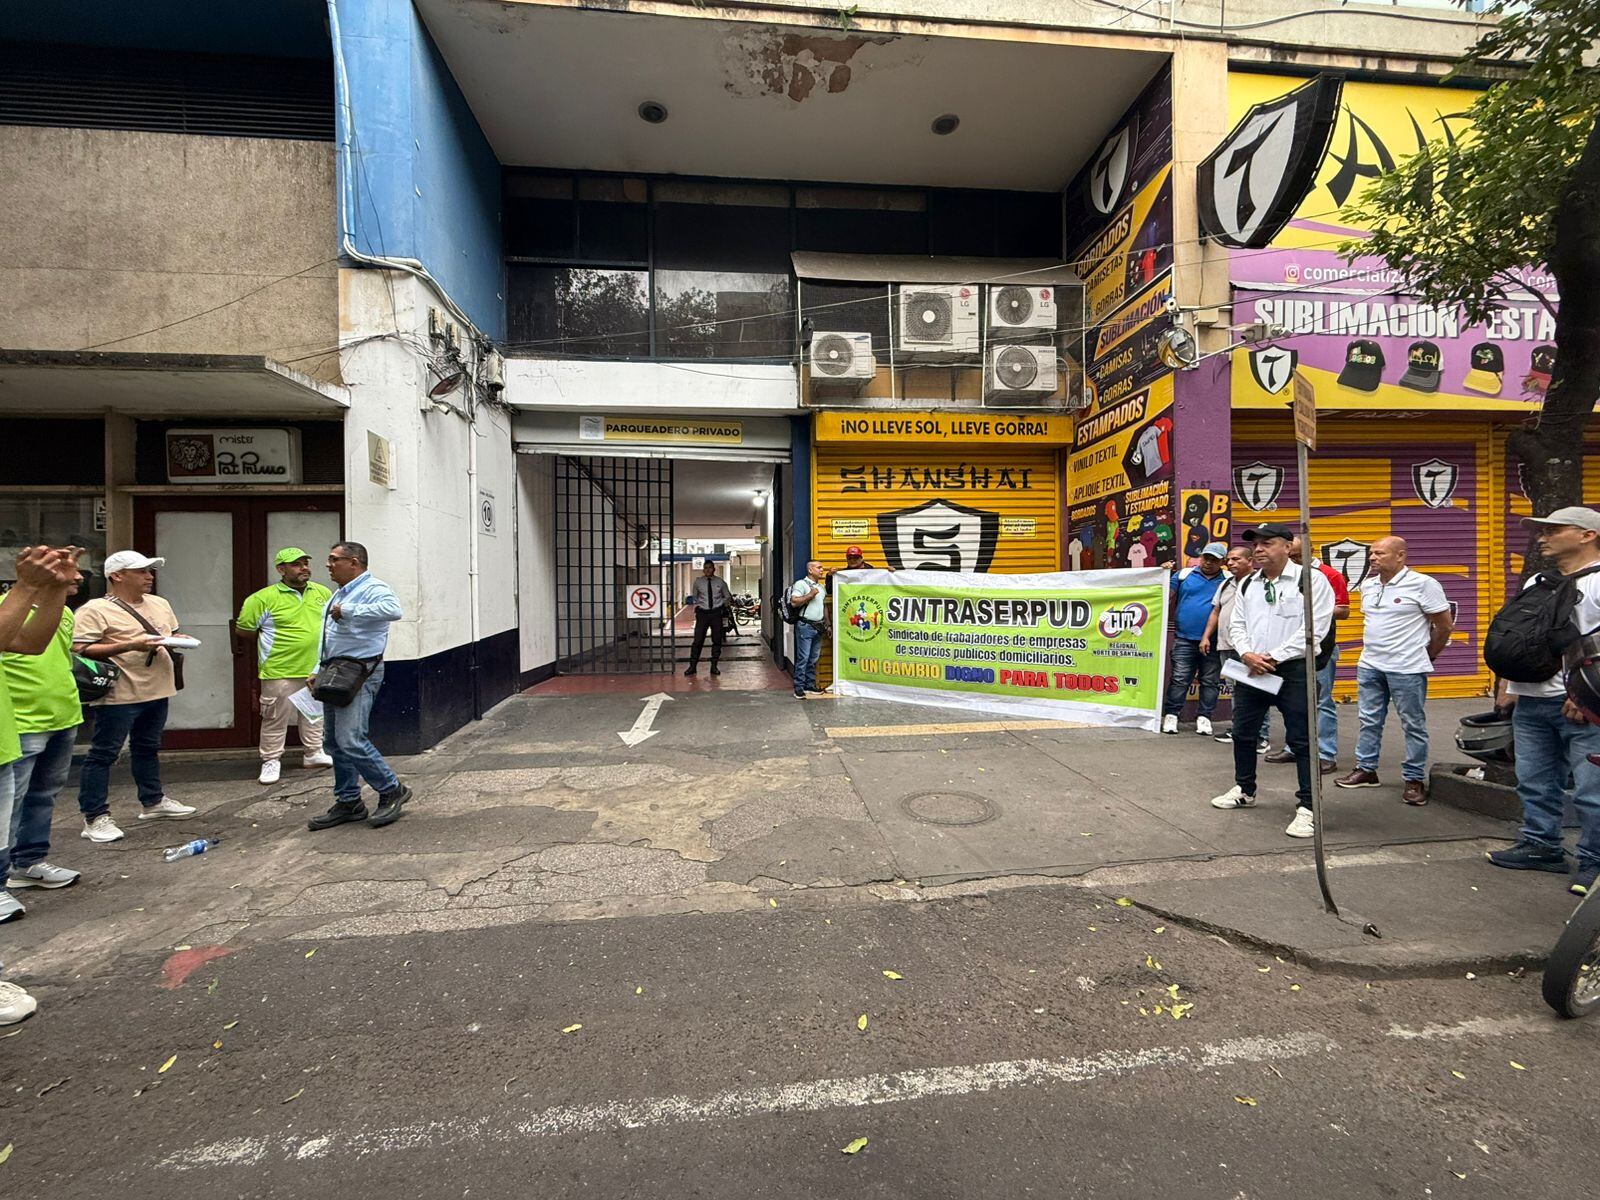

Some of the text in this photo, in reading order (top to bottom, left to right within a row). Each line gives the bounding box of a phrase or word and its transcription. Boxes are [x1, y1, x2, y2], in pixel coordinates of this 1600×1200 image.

[1086, 251, 1124, 295] CAMISETAS
[1095, 283, 1124, 316] GORRAS
[1486, 306, 1557, 341] ESTA
[1099, 347, 1133, 379] CAMISAS
[1103, 375, 1133, 404] GORRAS
[606, 424, 689, 434] PARQUEADERO
[692, 426, 740, 436] PRIVADO
[873, 420, 912, 434] LLEVE
[915, 420, 948, 438] SOL,
[951, 421, 990, 435] LLEVE
[994, 421, 1048, 436] GORRA!
[1077, 396, 1144, 446] ESTAMPADOS
[1073, 444, 1118, 472] VINILO TEXTIL
[1074, 472, 1125, 501] APLIQUE TEXTIL
[1130, 494, 1169, 514] ESTAMPADO
[886, 597, 1091, 629] SINTRASERPUD
[888, 628, 929, 642] Sindicato
[932, 631, 943, 642] de
[946, 631, 1010, 646] trabajadores
[1012, 634, 1026, 647] de
[1029, 637, 1087, 650] empresas
[1109, 642, 1137, 650] REGIONAL
[895, 644, 1076, 666] de servicios publicos domiciliarios.
[883, 661, 941, 680] CAMBIO
[945, 666, 995, 684] DIGNO
[999, 669, 1049, 689] PARA
[1054, 673, 1119, 694] TODOS
